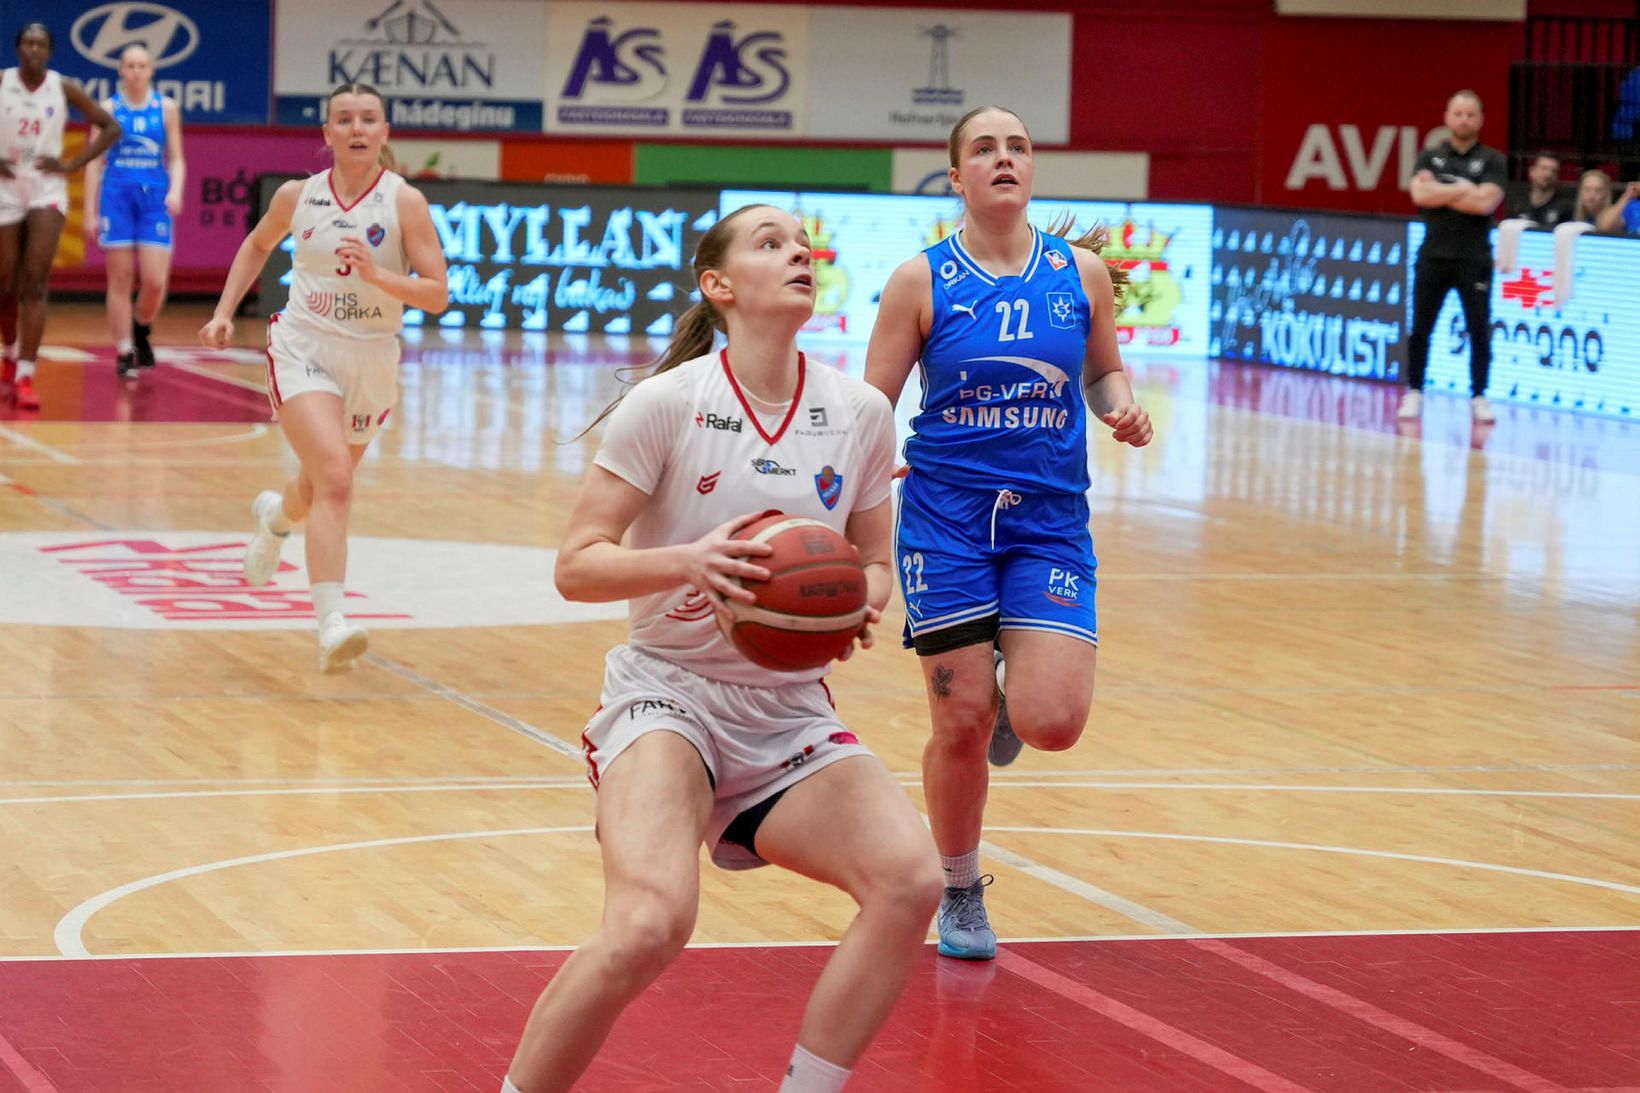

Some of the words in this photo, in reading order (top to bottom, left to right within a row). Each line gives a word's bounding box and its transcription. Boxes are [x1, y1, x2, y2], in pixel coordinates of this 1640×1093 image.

[328, 50, 495, 87] KÆNAN
[18, 117, 41, 136] 24
[335, 293, 358, 307] HS
[335, 306, 382, 321] ORKA
[995, 298, 1034, 342] 22
[706, 413, 742, 433] Rafal
[942, 405, 1068, 430] SAMSUNG
[903, 553, 929, 595] 22
[1048, 567, 1080, 592] PK
[1048, 585, 1078, 600] VERK
